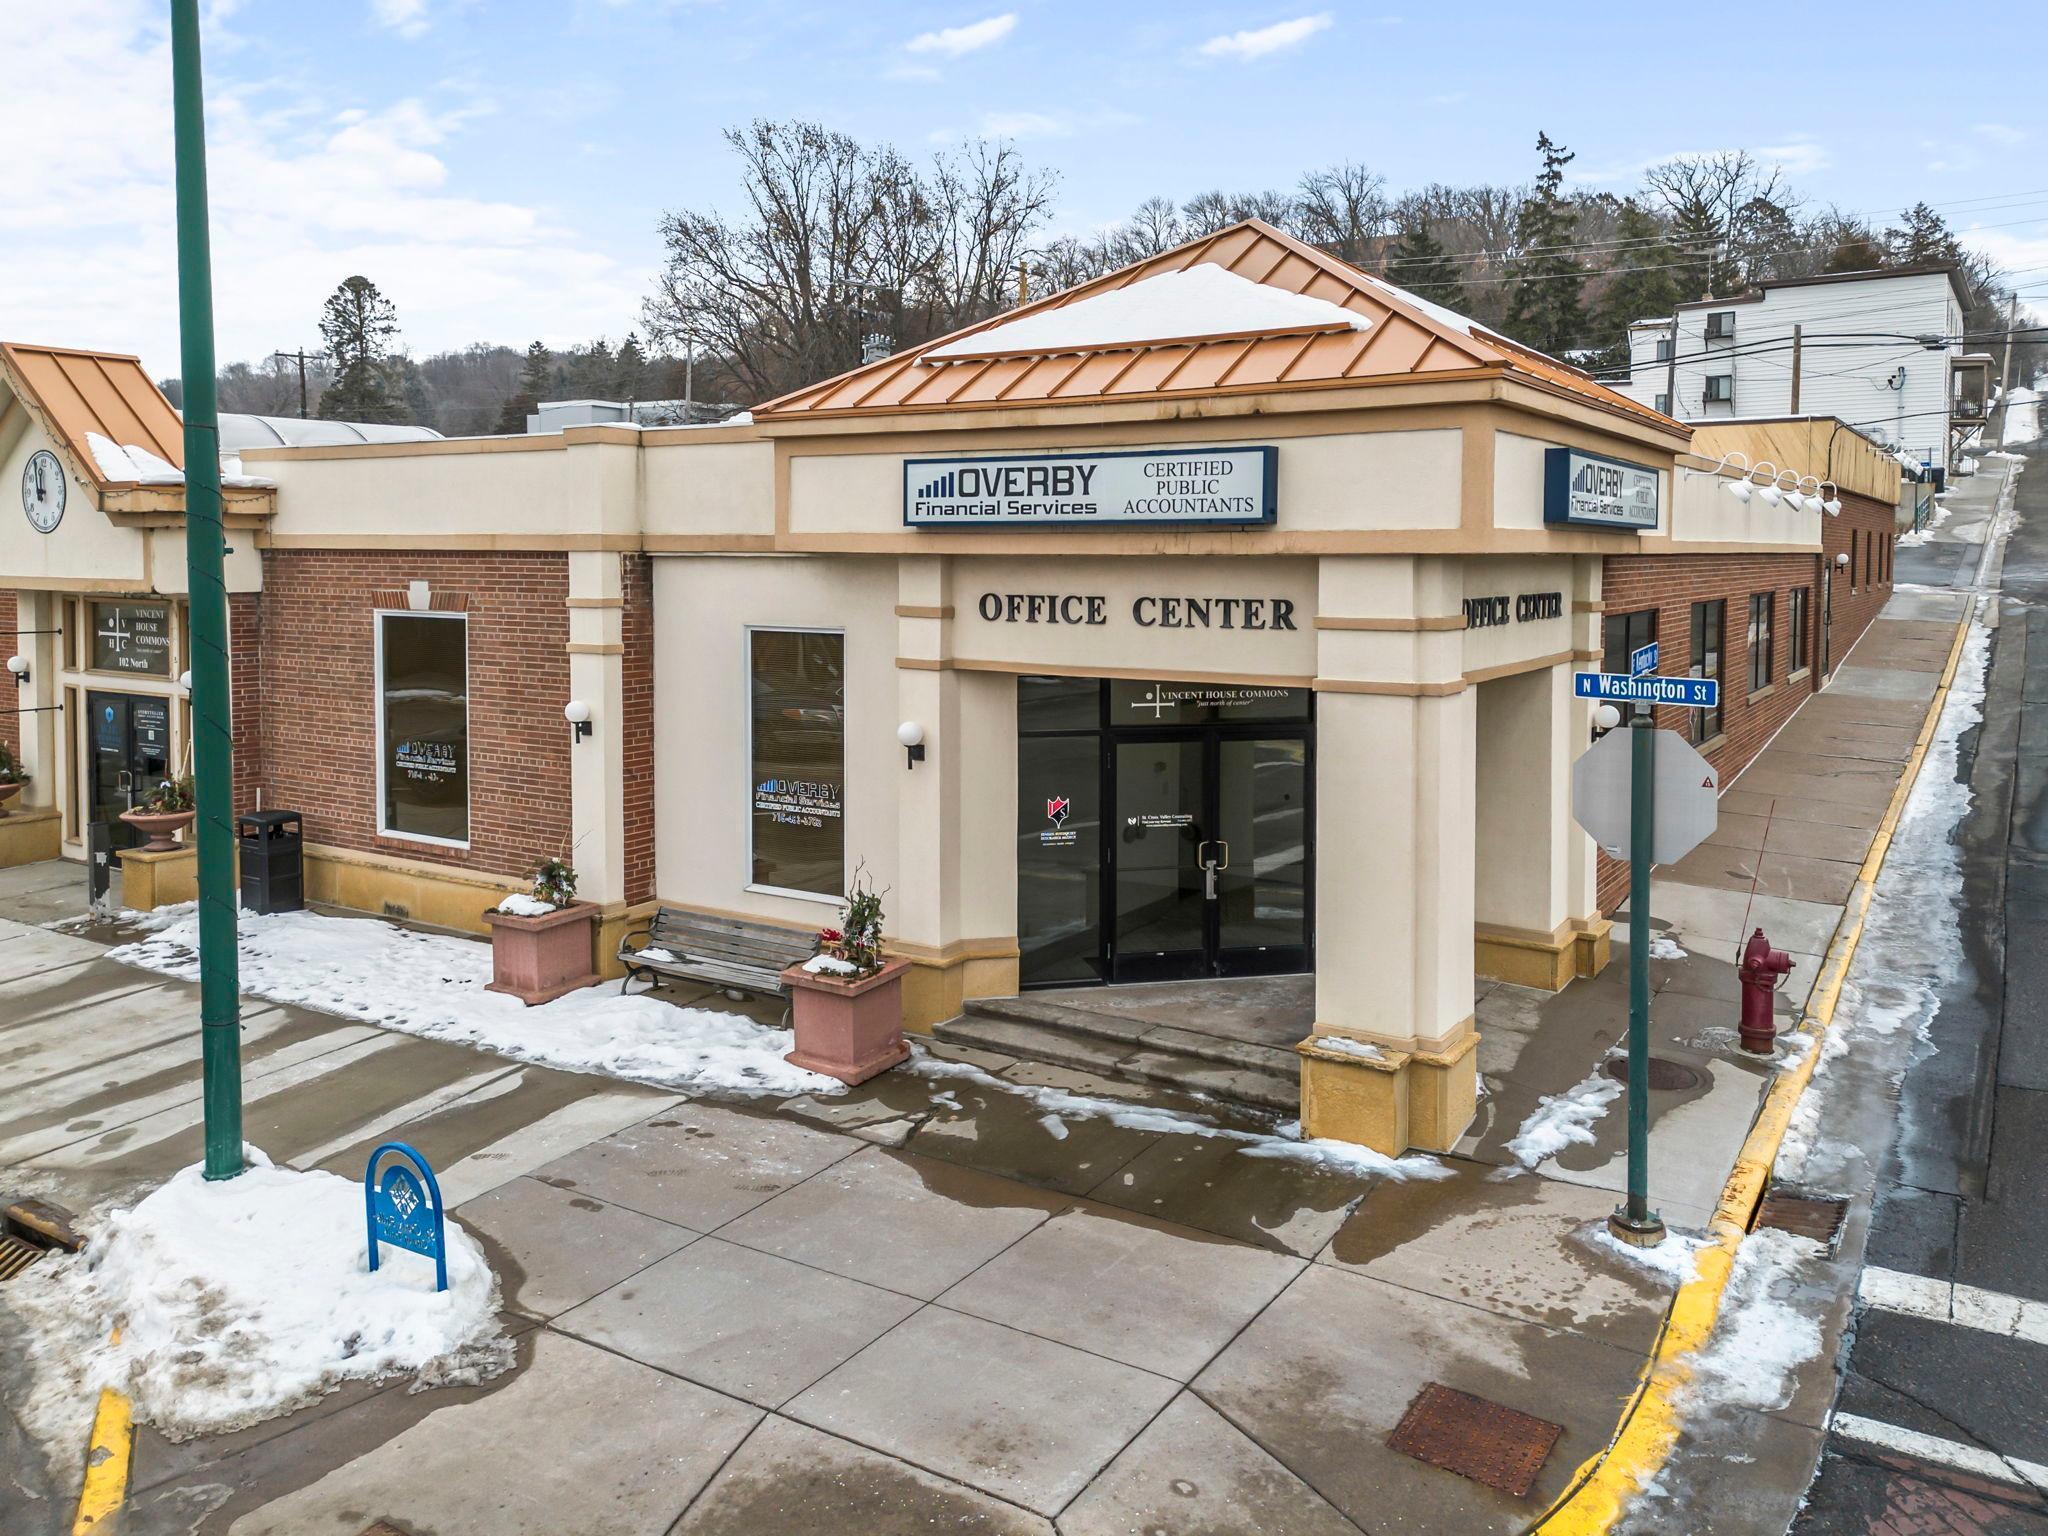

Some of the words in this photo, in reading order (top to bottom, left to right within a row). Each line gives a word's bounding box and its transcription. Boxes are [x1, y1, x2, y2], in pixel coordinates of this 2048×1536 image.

[1144, 460, 1234, 478] CERTIFIED
[958, 464, 1098, 497] OVERBY
[1156, 479, 1220, 496] PUBLIC
[1585, 463, 1624, 499] OVERBY
[915, 500, 1001, 517] Financial
[1008, 500, 1098, 516] Services
[1123, 497, 1254, 515] ACCOUNTANTS
[1571, 495, 1598, 513] Financial
[1600, 499, 1624, 516] Services
[136, 609, 164, 619] VINCENT
[979, 592, 1107, 625] OFFICE
[1132, 596, 1298, 630] CENTER
[1516, 592, 1563, 622] CENTER
[136, 622, 158, 632] HOUSE
[119, 657, 129, 667] 102
[130, 658, 149, 669] North
[1161, 691, 1204, 700] VINCENT
[1205, 690, 1237, 699] HOUSE
[1239, 689, 1289, 699] COMMONS
[1583, 678, 1590, 693] N
[1599, 675, 1685, 701] Washington
[1694, 685, 1707, 701] St
[778, 780, 841, 799] OVERBY
